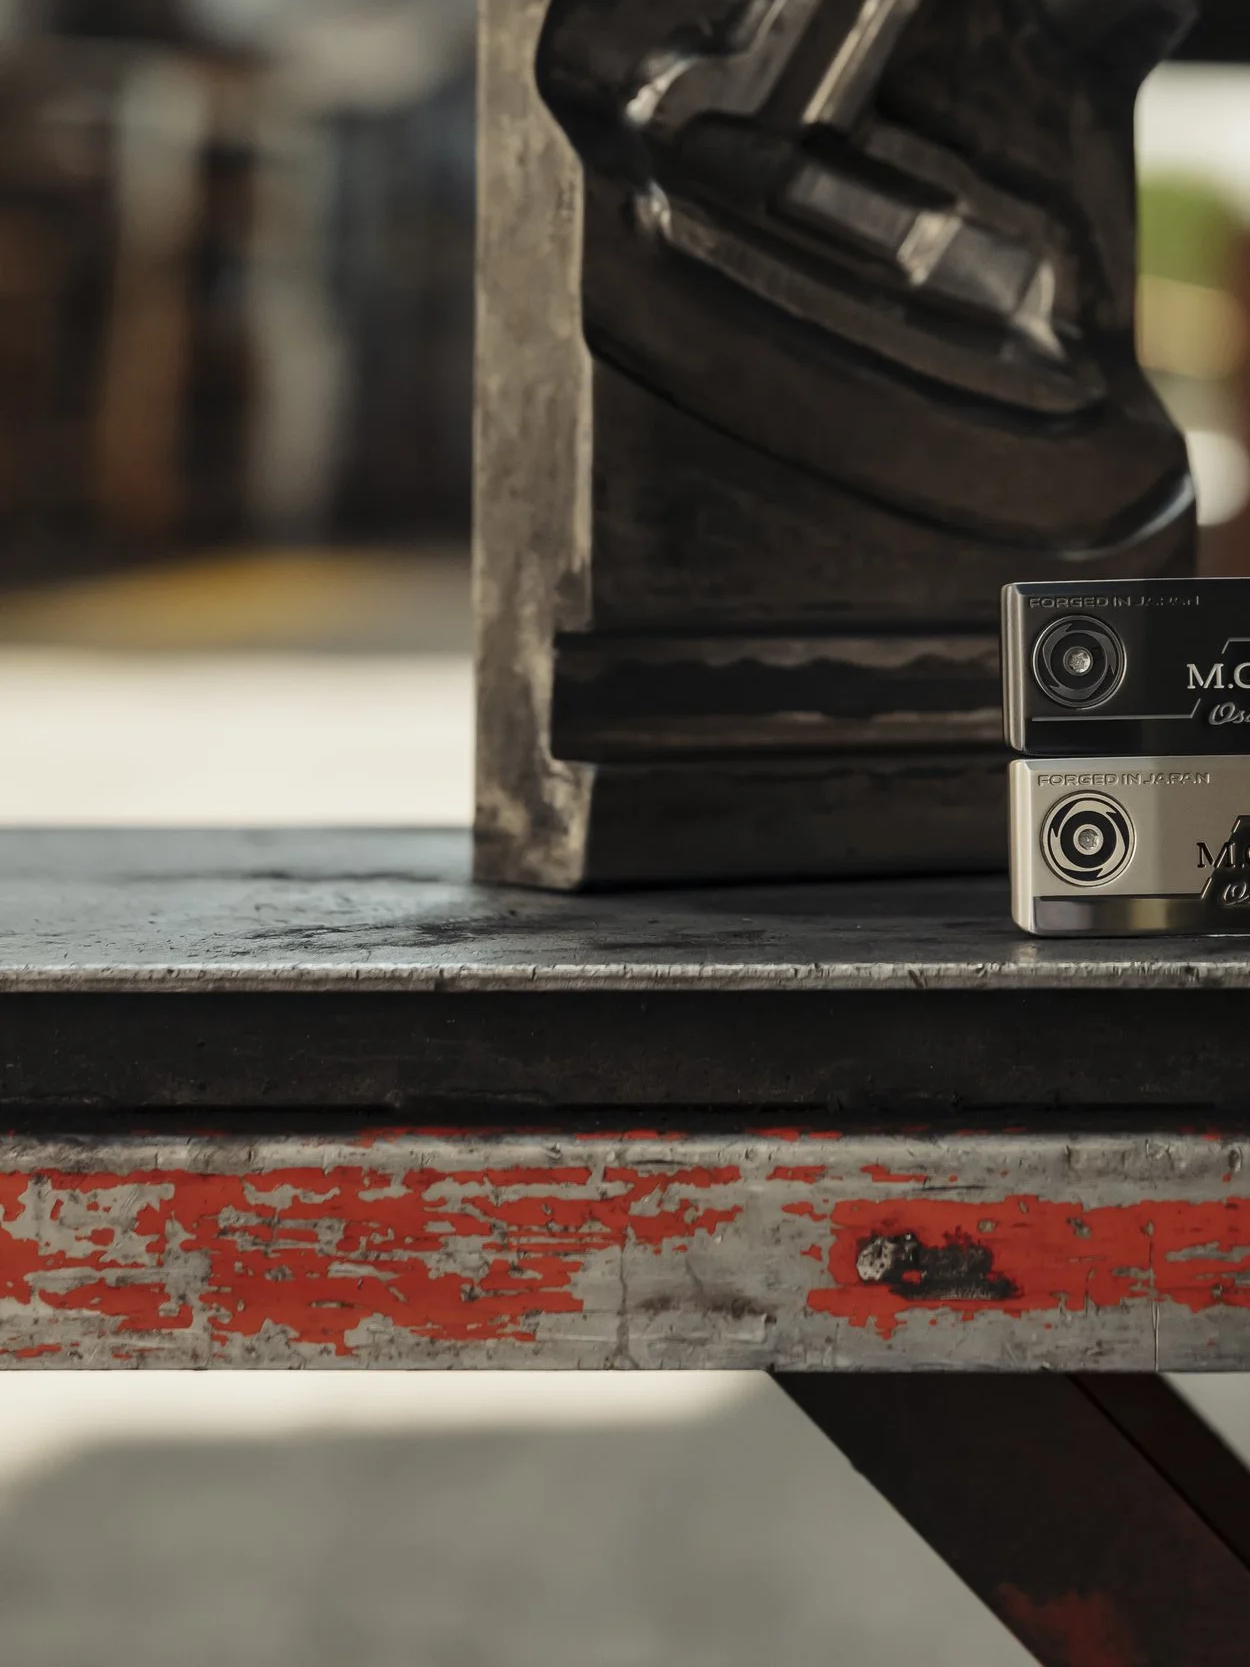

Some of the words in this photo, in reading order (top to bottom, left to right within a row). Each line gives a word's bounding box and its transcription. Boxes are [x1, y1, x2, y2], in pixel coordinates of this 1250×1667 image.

[1029, 596, 1109, 608] FORGED
[1112, 596, 1131, 607] IN
[1037, 773, 1119, 787] FORGED
[1122, 773, 1141, 786] IN
[1143, 772, 1210, 785] JAPAN
